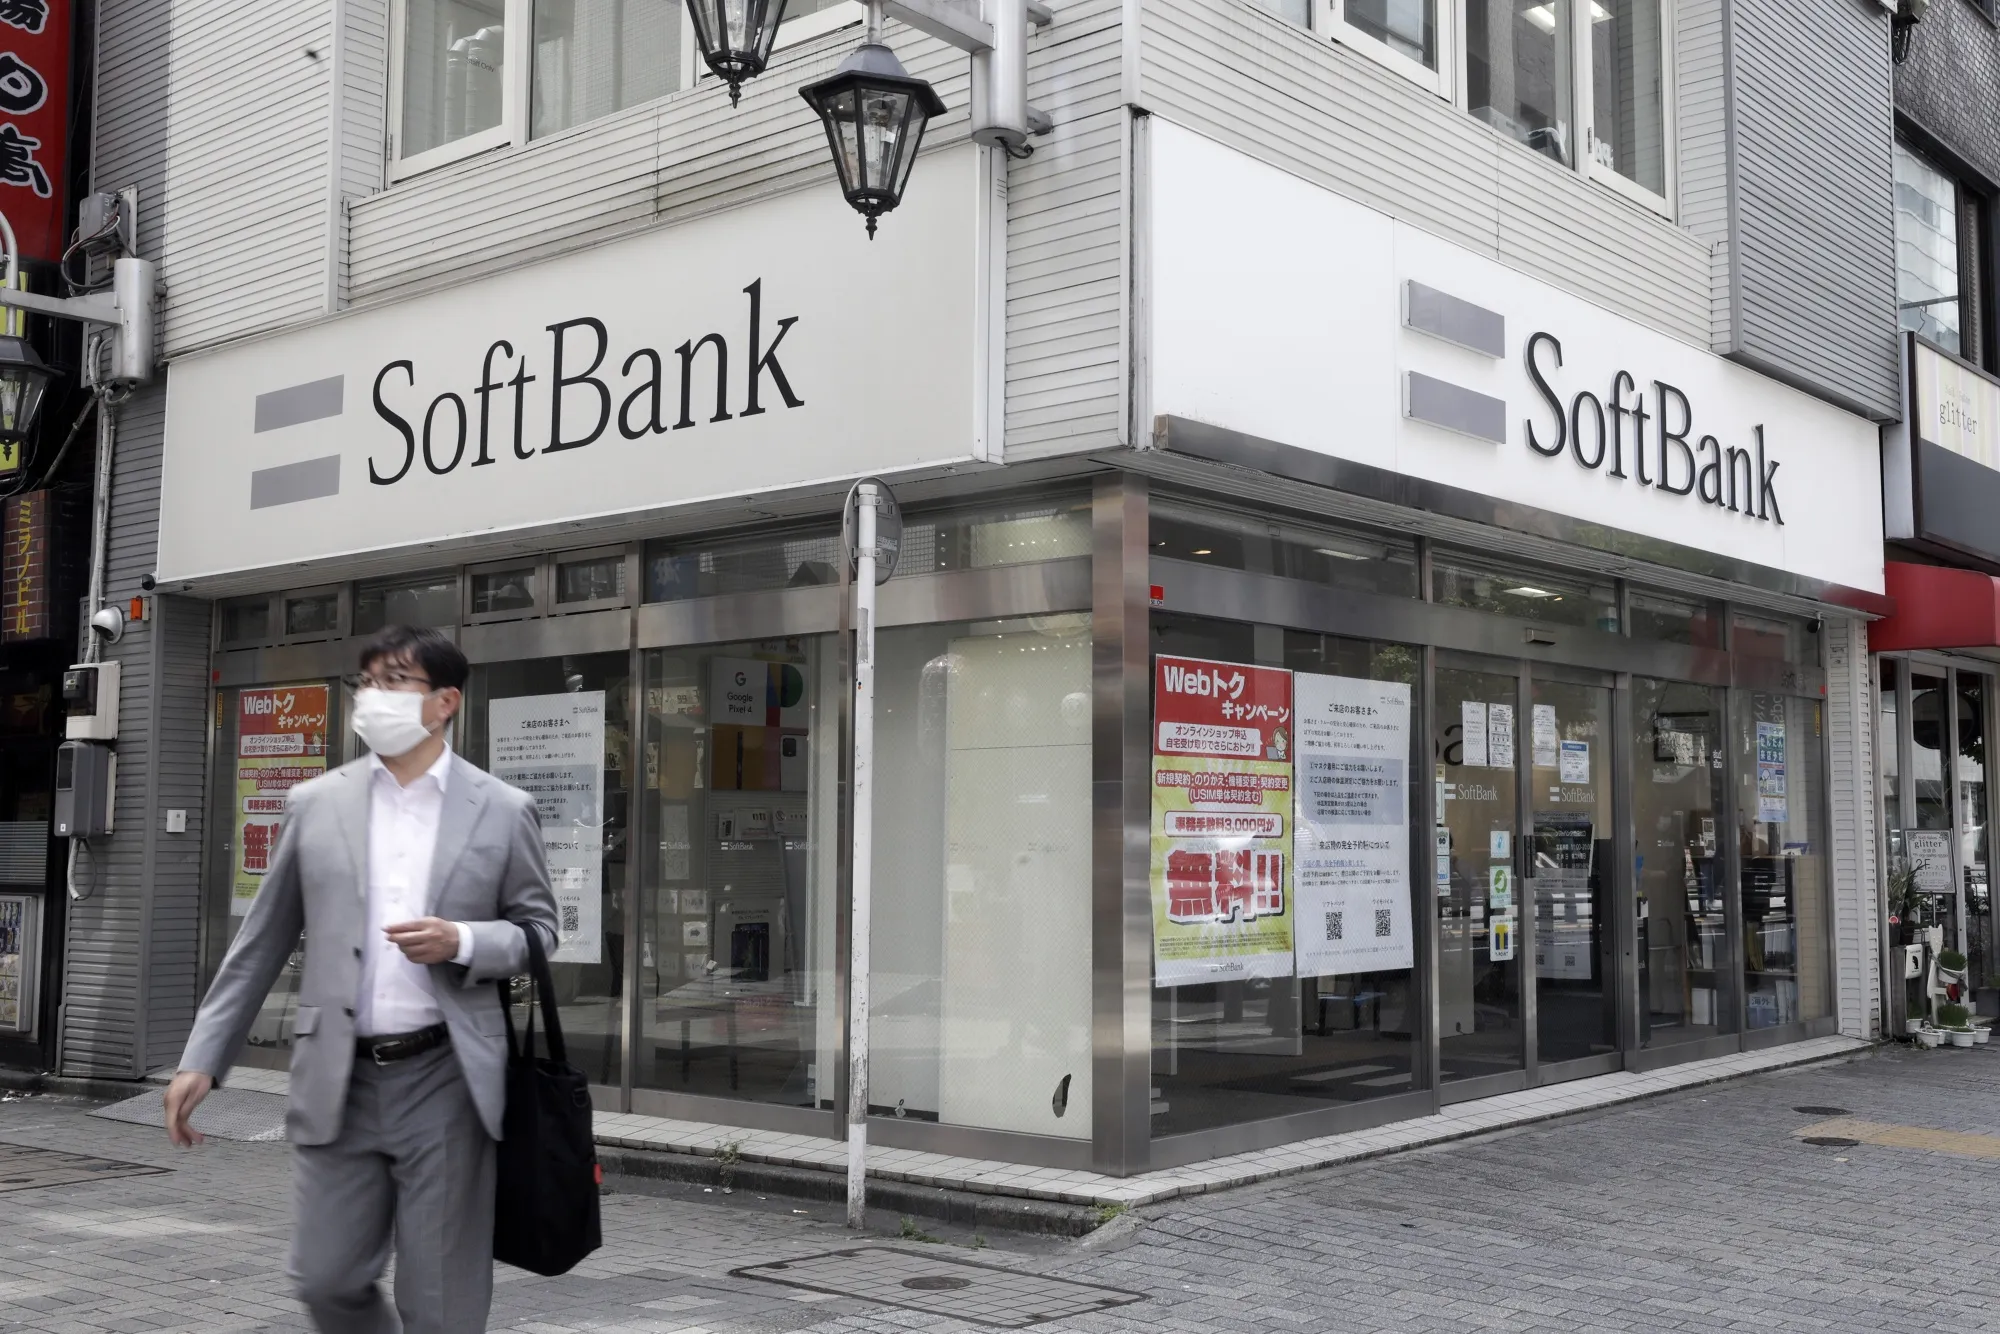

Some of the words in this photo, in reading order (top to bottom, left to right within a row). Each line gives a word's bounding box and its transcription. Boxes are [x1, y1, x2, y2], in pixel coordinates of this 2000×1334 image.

[368, 277, 805, 486] SoftBank
[1940, 400, 1977, 434] glitter
[1524, 331, 1785, 526] SoftBank
[1163, 665, 1245, 699] Webトク
[244, 692, 295, 715] Webトク
[727, 691, 753, 703] Google
[728, 705, 746, 713] Pixel
[1222, 700, 1289, 723] キャンペーン
[1328, 703, 1379, 715] ご来店のお客さまへ
[278, 714, 325, 728] キャンペーン
[521, 718, 571, 729] ご来店のお客さまへ
[1175, 725, 1247, 740] オンラインショップ申込
[1458, 783, 1498, 801] SoftBank
[1561, 787, 1596, 803] SoftBank
[667, 842, 691, 850] SoftBank
[729, 842, 753, 850] SoftBank
[1914, 840, 1942, 849] glitter
[1916, 858, 1930, 870] 2F
[1751, 996, 1770, 1006] 海外
